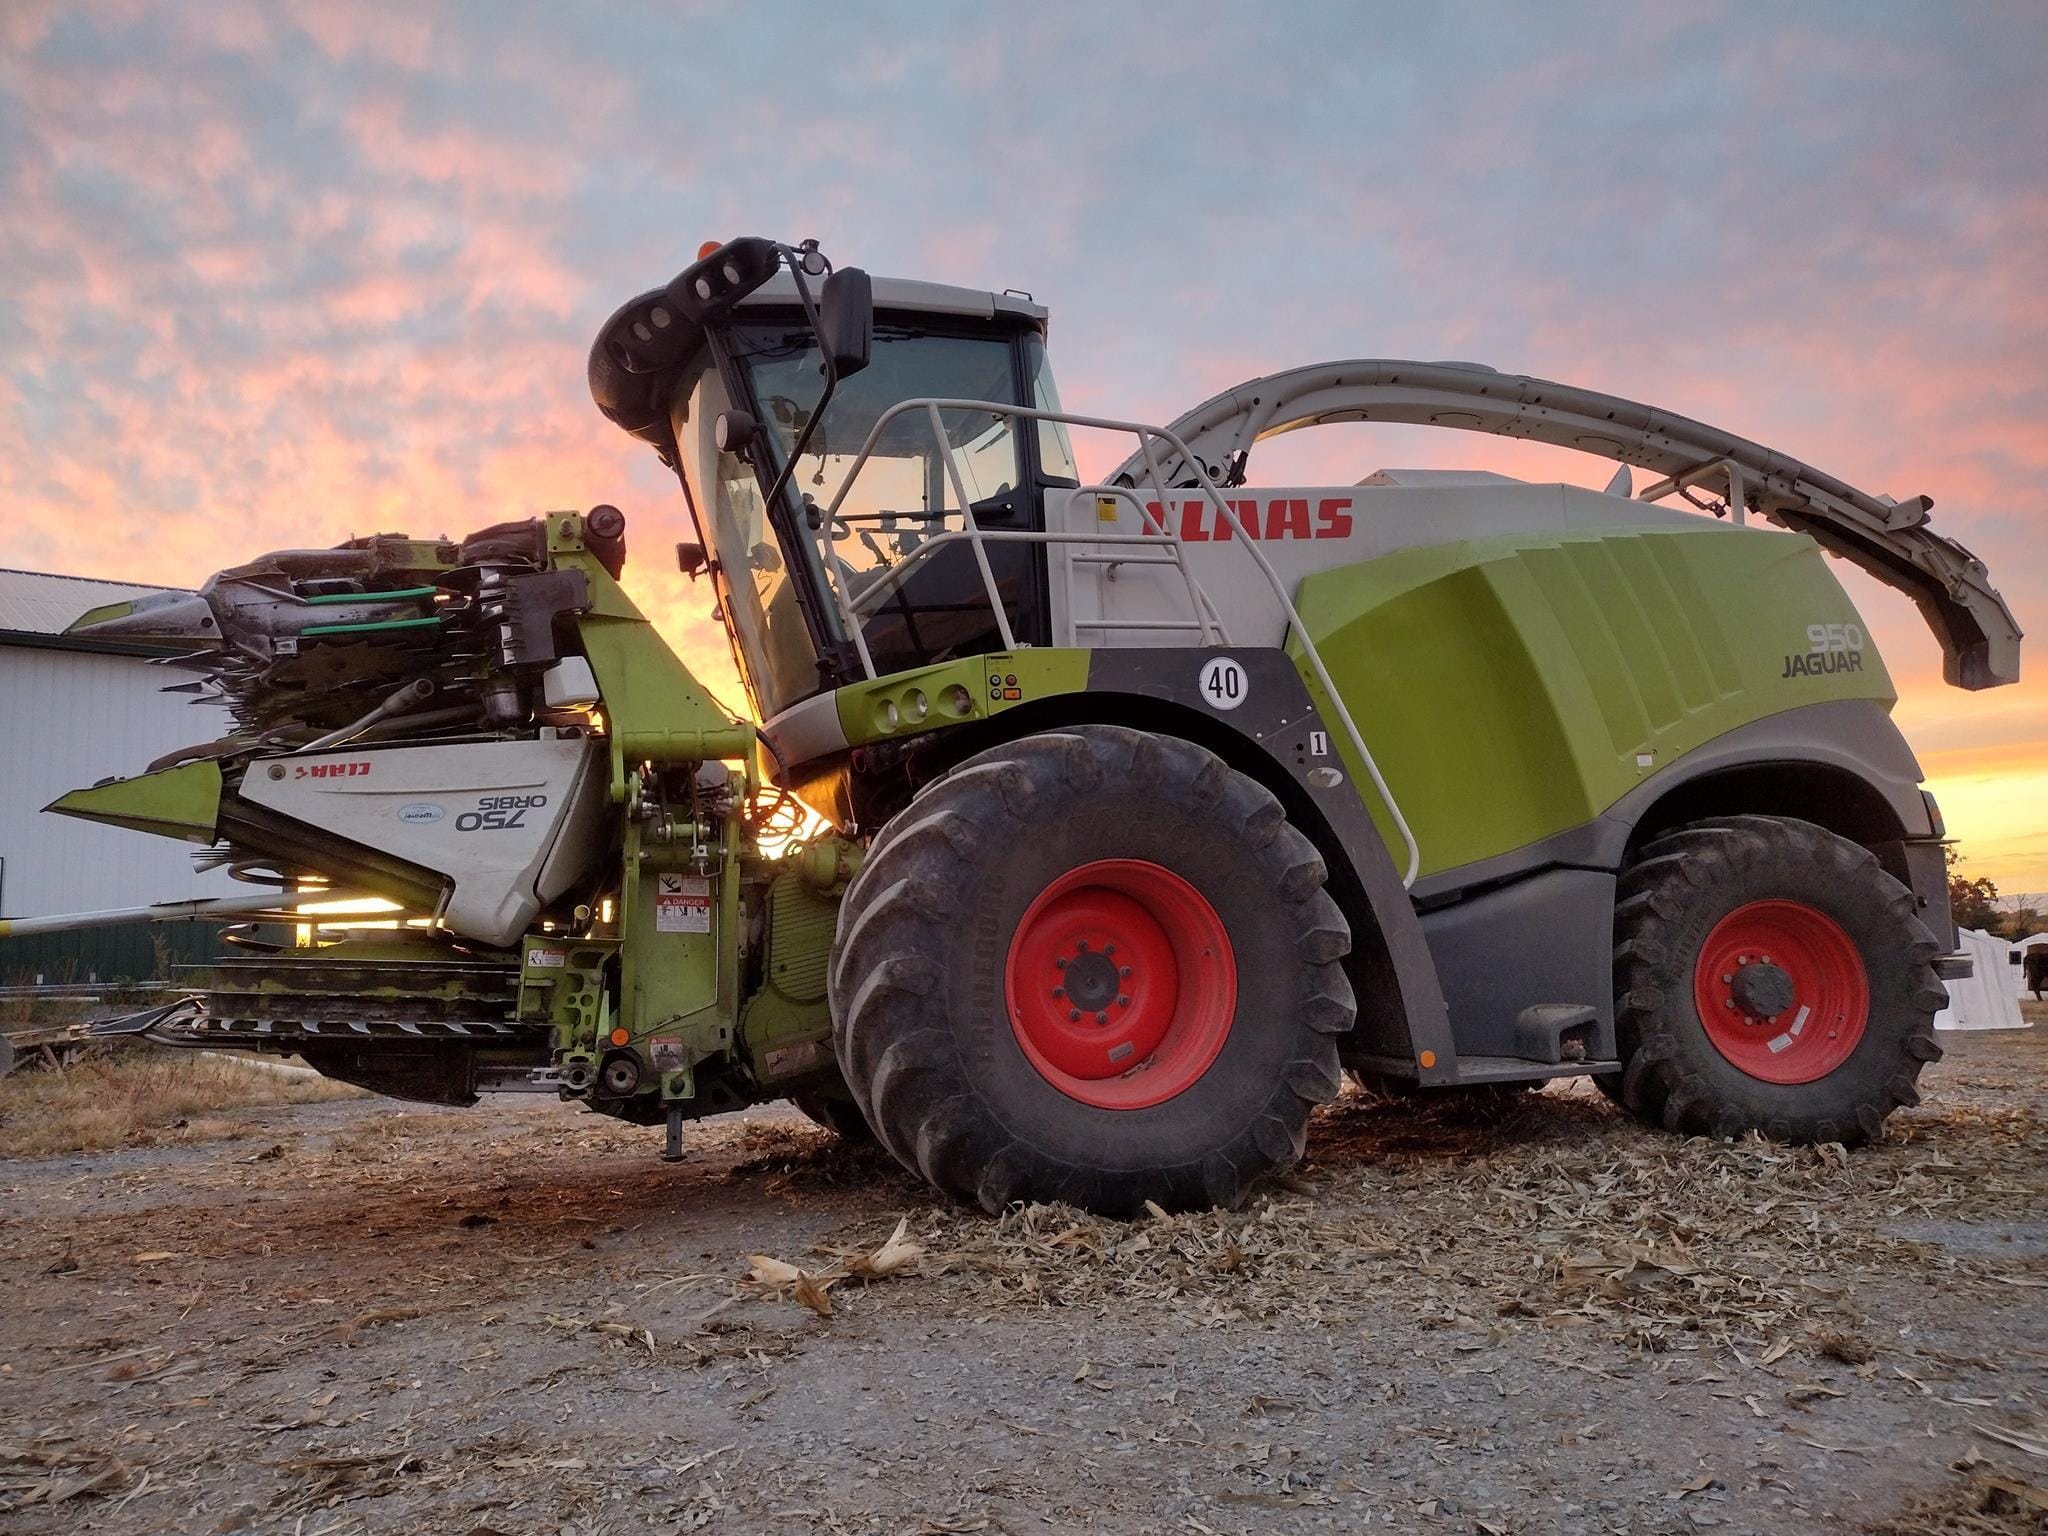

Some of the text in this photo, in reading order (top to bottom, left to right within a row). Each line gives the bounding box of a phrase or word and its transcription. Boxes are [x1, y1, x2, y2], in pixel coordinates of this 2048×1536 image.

[1806, 623, 1863, 652] 950
[1782, 651, 1864, 678] JAGUAR
[1208, 666, 1239, 699] 40
[478, 795, 548, 811] ORBIS
[455, 809, 527, 832] 750
[672, 898, 705, 906] DANGER
